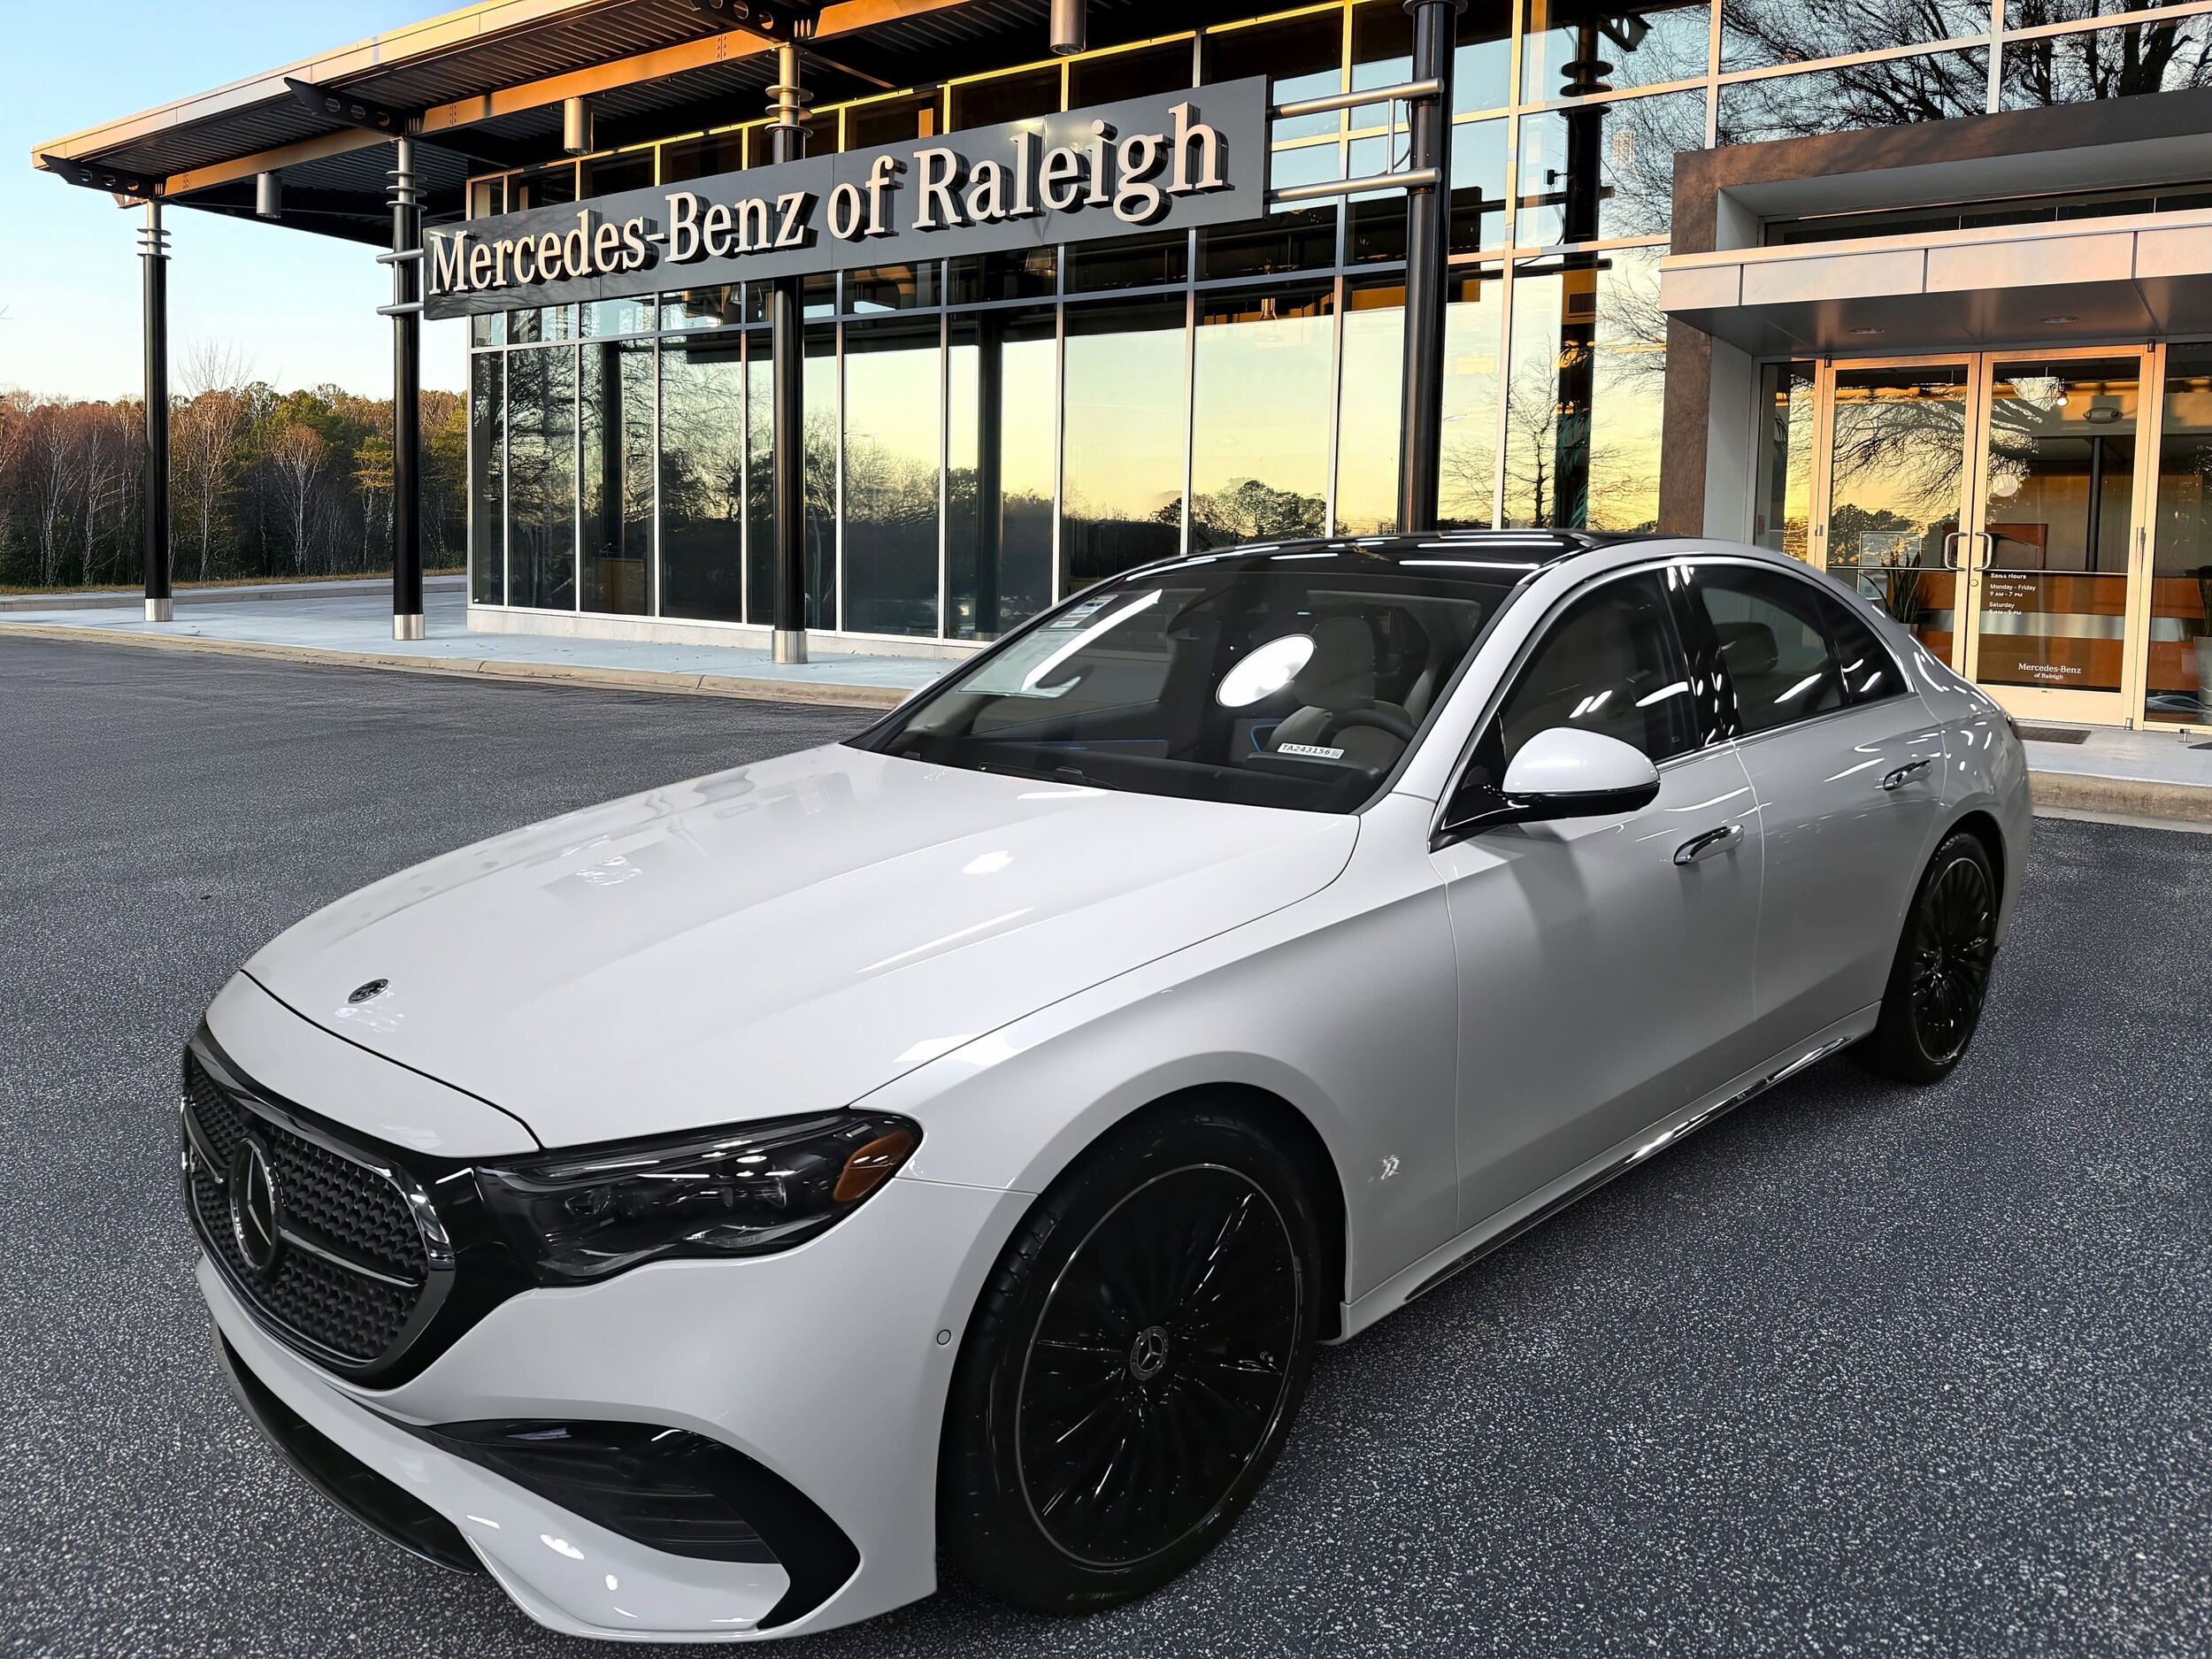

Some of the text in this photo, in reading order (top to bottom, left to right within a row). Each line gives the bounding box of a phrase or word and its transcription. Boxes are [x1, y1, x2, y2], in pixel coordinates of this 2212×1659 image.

[428, 101, 1225, 296] Mercedes-Benz of Raleigh
[2018, 663, 2081, 673] Mercedes-Benz
[1282, 744, 1331, 755] TA243156
